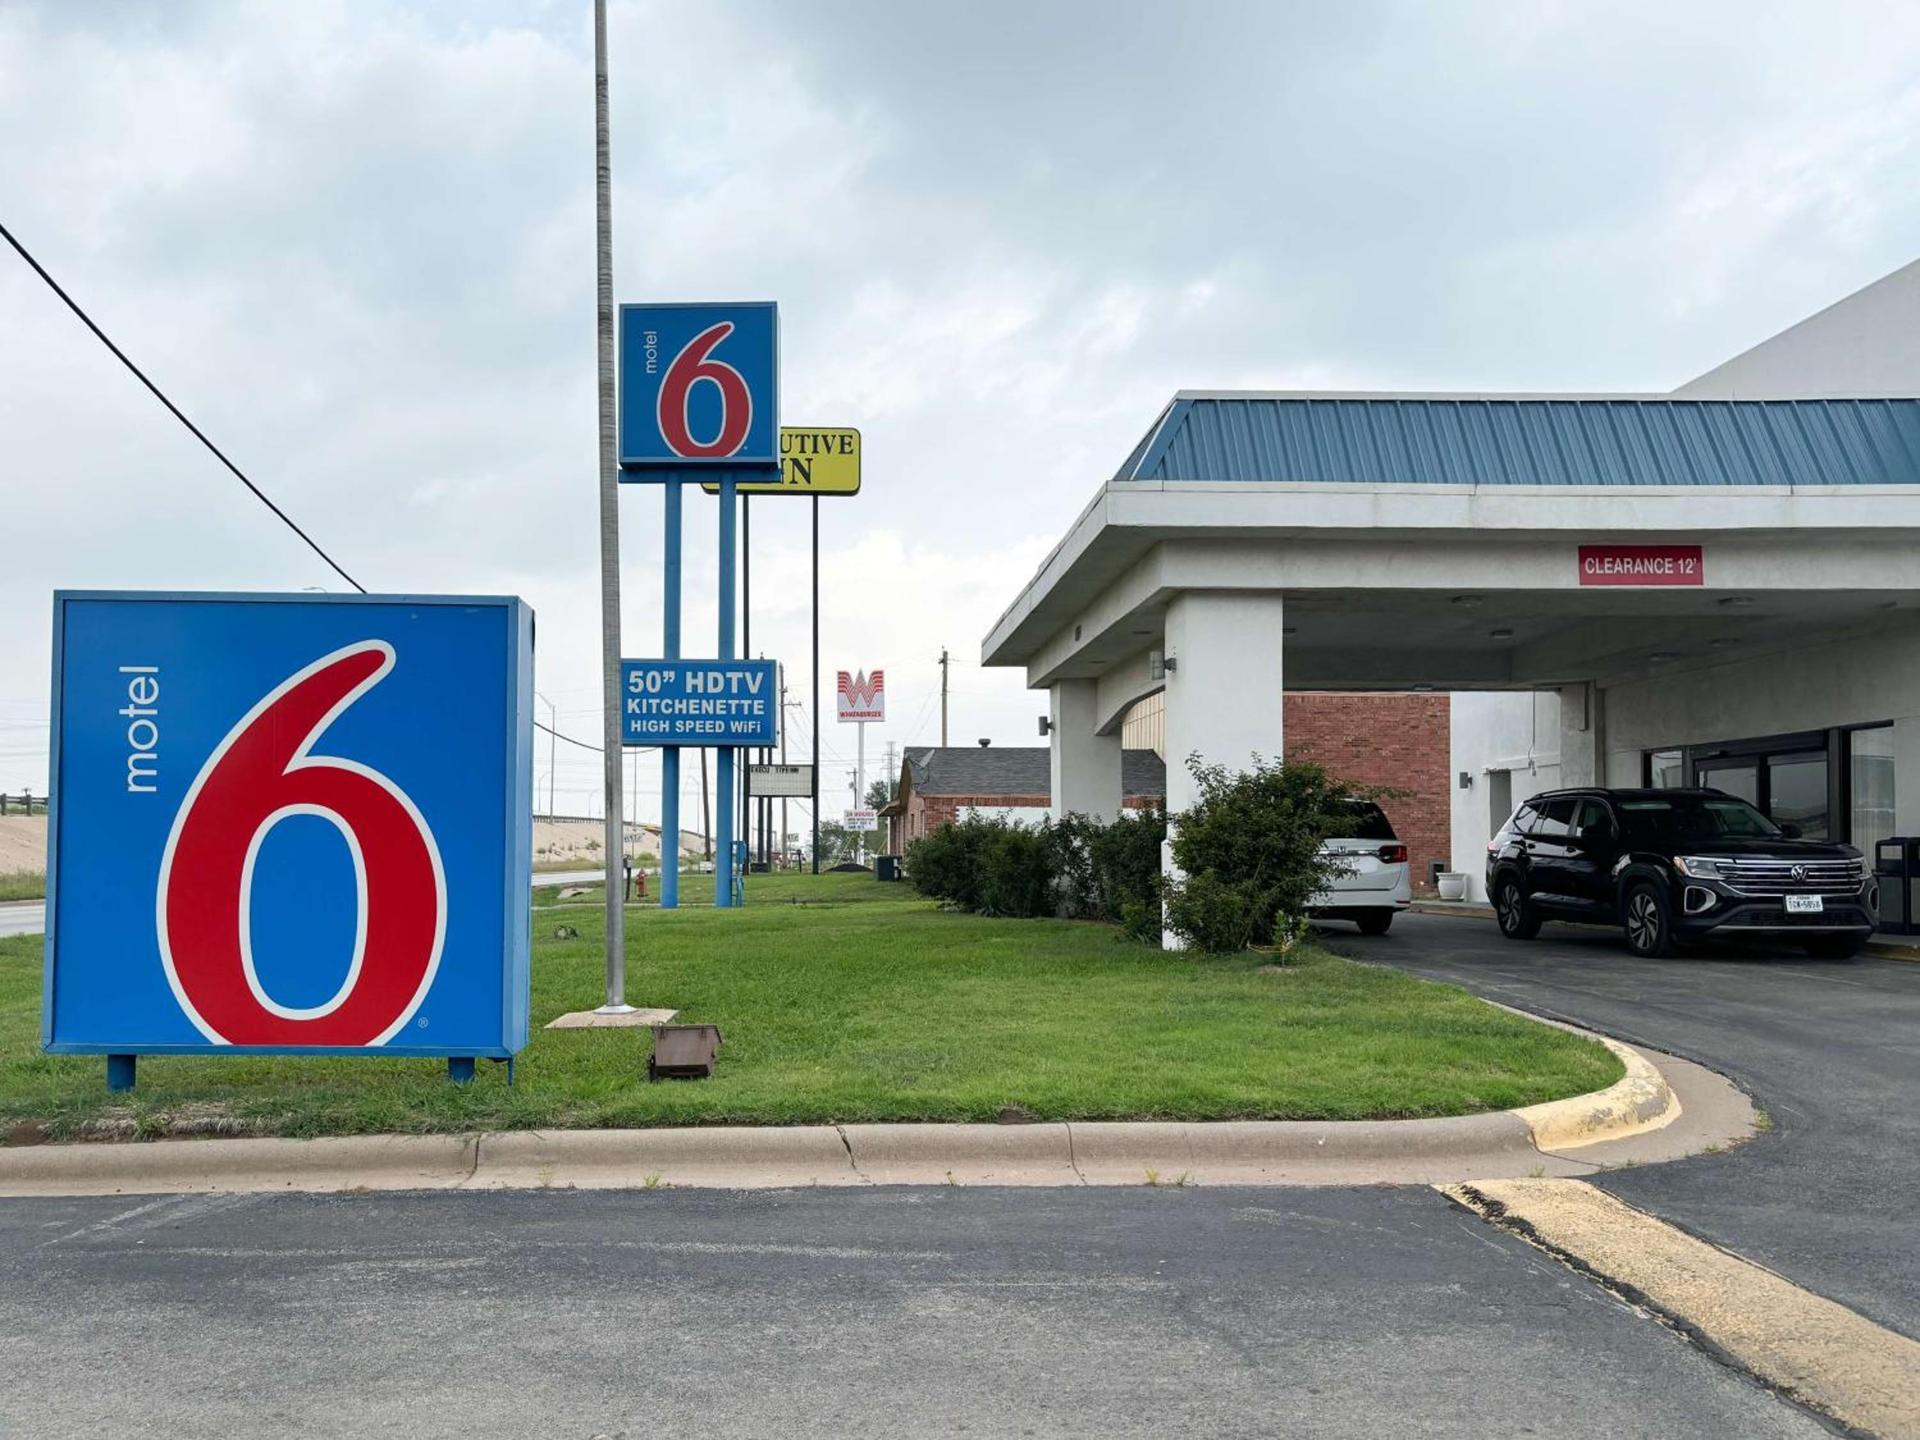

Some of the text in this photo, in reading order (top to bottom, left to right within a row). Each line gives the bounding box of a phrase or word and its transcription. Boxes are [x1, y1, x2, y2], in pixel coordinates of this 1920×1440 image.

[643, 330, 658, 374] motel
[656, 320, 753, 458] 6
[1584, 557, 1697, 574] CLEARANCE 12'
[685, 671, 764, 693] HDTV
[627, 698, 765, 715] KITCHENETTE
[119, 665, 159, 792] motel
[630, 720, 761, 733] HIGH SPEED WiFi
[156, 639, 448, 1046] 6
